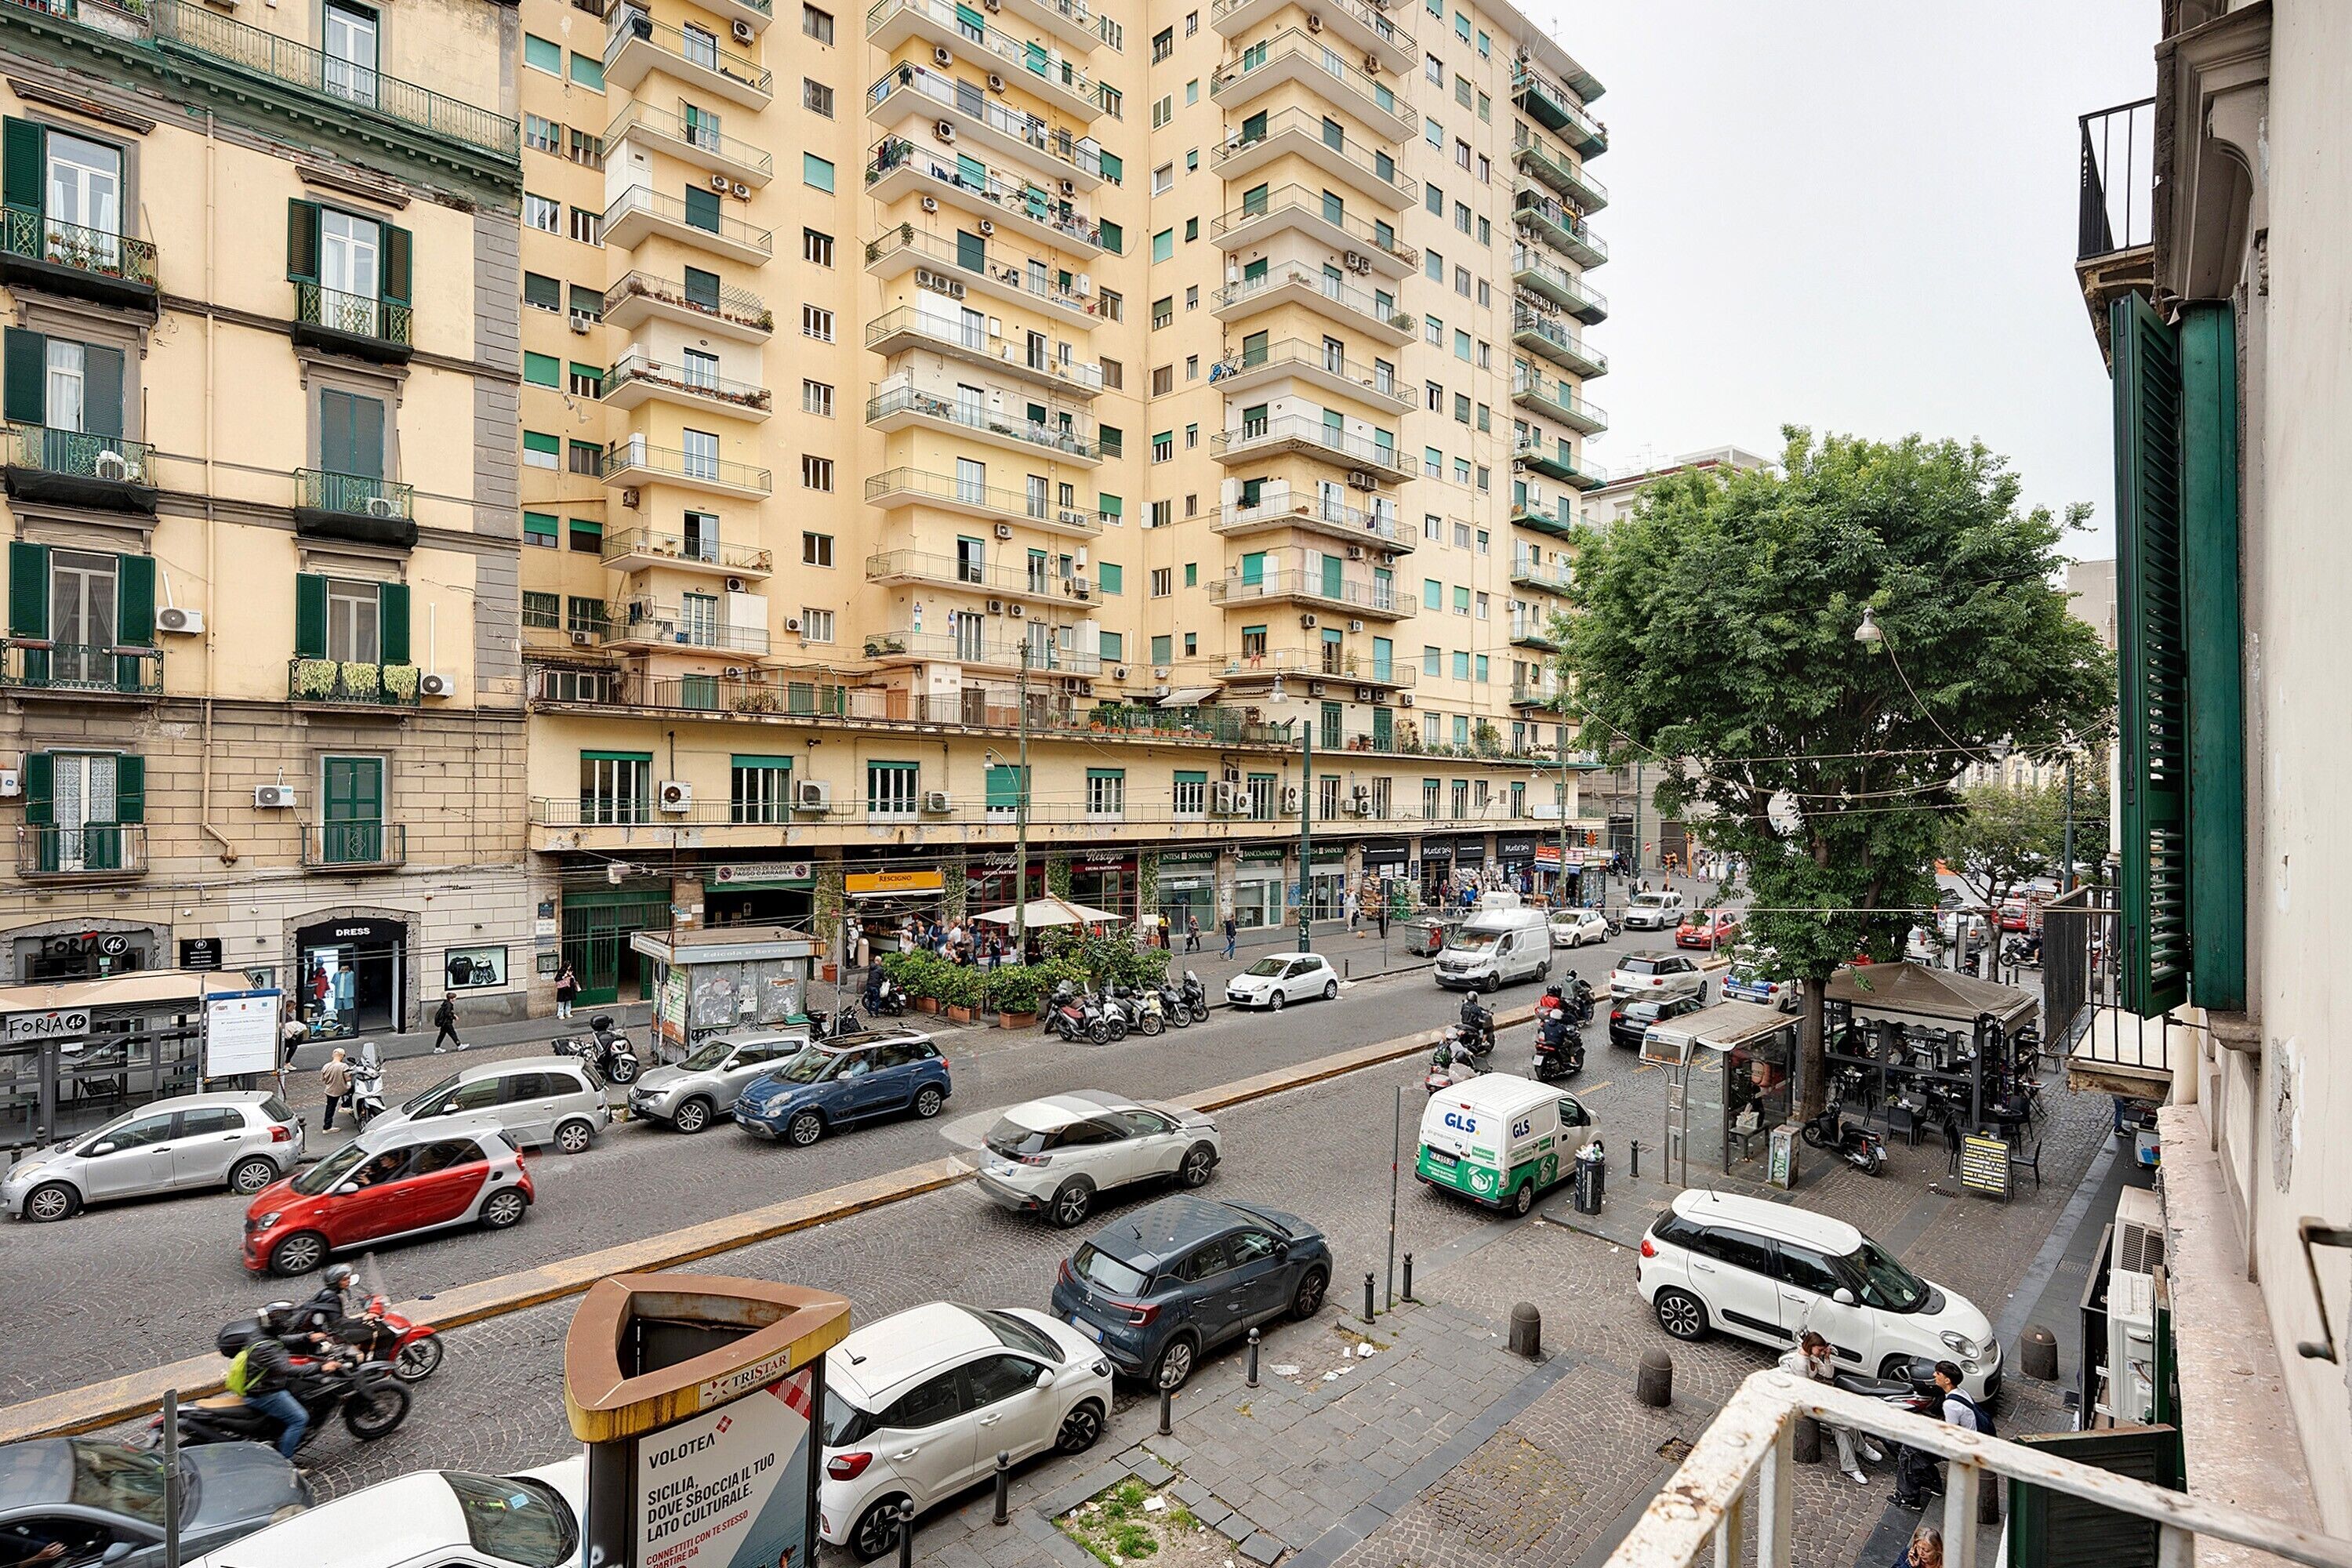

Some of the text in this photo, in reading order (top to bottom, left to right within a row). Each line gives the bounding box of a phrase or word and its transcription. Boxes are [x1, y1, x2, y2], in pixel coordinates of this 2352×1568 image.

[107, 938, 124, 953] 46
[336, 927, 371, 937] DRESS
[68, 1016, 82, 1029] 46
[1965, 1144, 2005, 1154] FOTOTESSERA
[732, 1355, 787, 1387] TRISTAR
[649, 1432, 715, 1469] VOLOTEA
[648, 1453, 775, 1525] DOVE SBOCCIA IL TUO
[648, 1475, 699, 1506] SICILIA,
[648, 1483, 753, 1543] LATO CULTURALE.
[646, 1510, 749, 1566] CONNETTITI CON TE STESSO
[688, 1546, 699, 1558] DA
